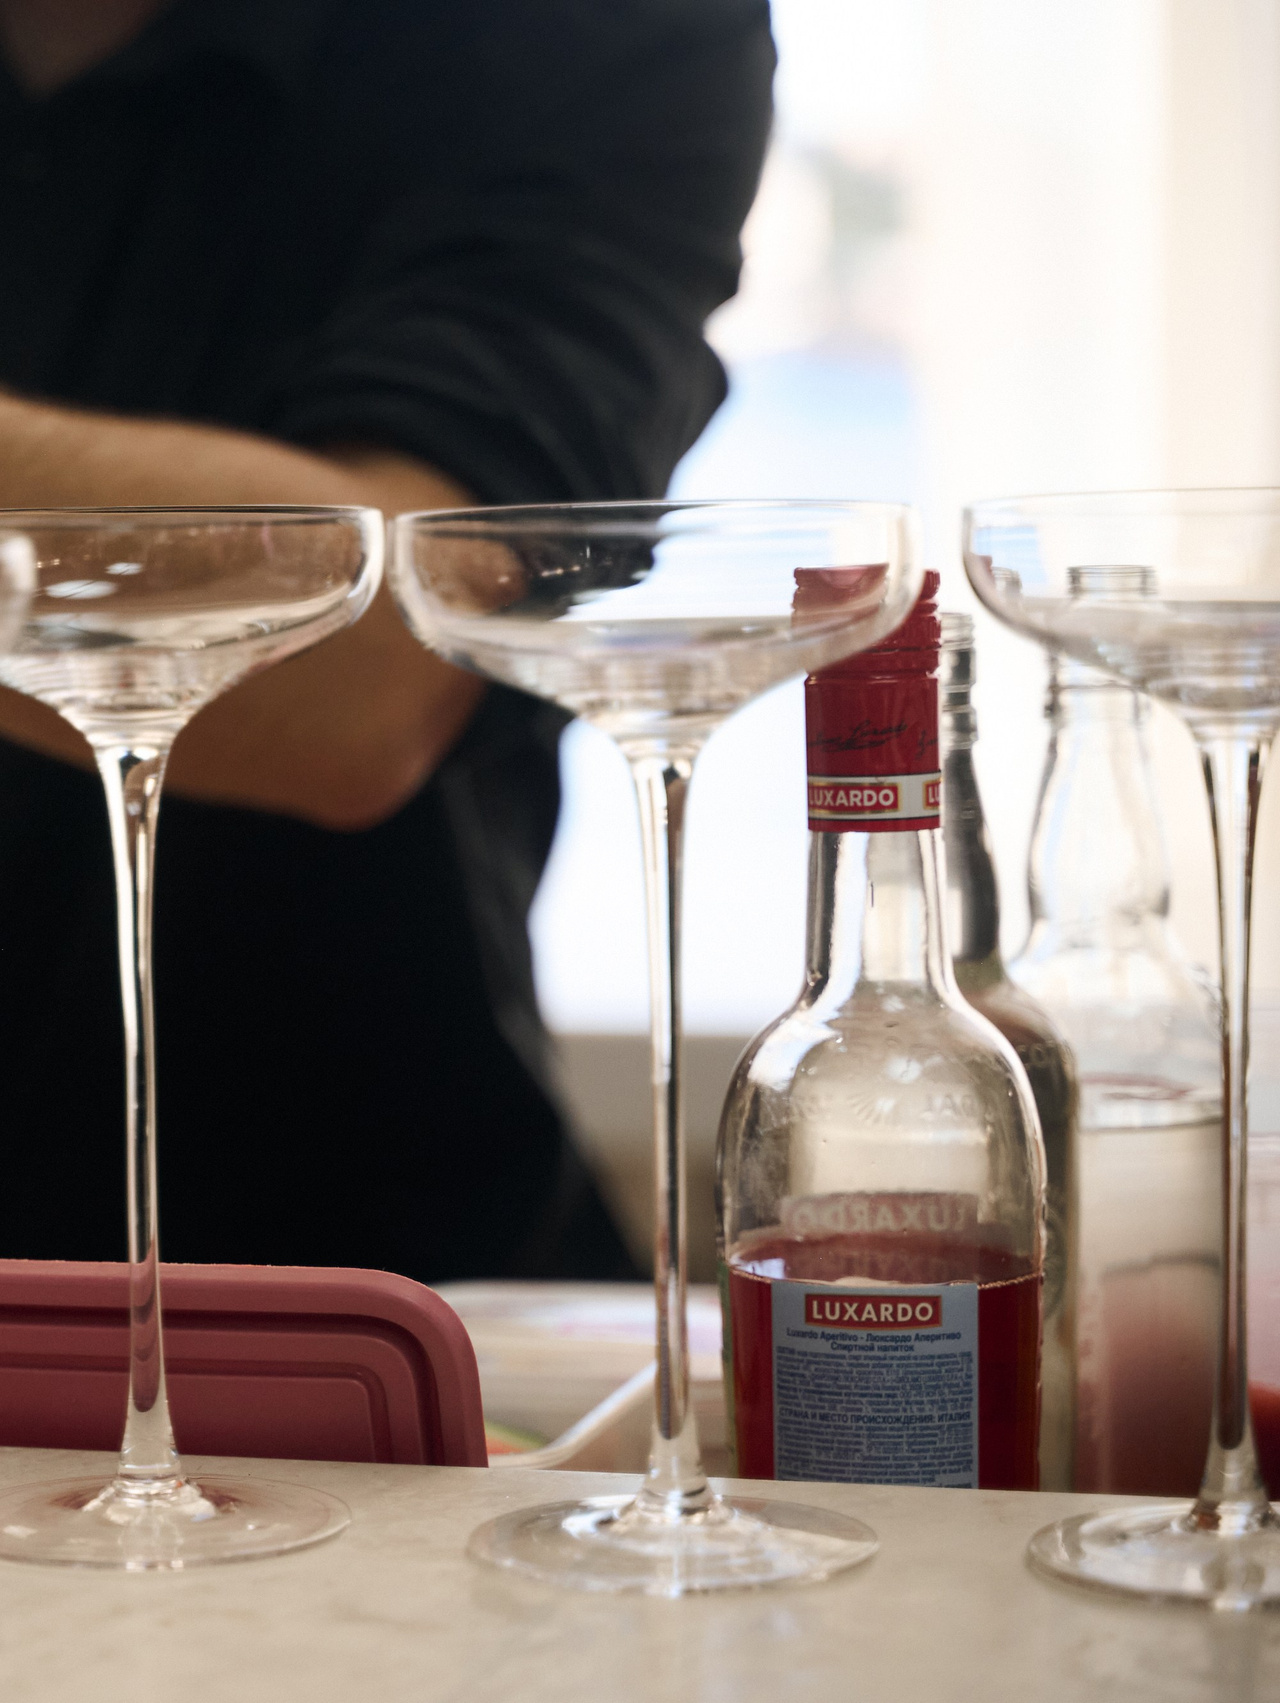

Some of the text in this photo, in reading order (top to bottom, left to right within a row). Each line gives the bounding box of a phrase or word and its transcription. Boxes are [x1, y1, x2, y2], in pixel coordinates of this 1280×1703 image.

[809, 789, 894, 806] LUXARDO
[812, 1300, 933, 1322] LUXARDO
[786, 1329, 818, 1339] Luxardo
[820, 1331, 858, 1343] Aperitivo
[866, 1332, 912, 1344] Люксардо
[914, 1330, 962, 1343] Аперитиво
[830, 1342, 915, 1352] Спиртной напиток
[779, 1407, 971, 1425] СТРАНА И МЕСТО ПРОИСХОЖДЕНИЯ: ИТАЛИЯ
